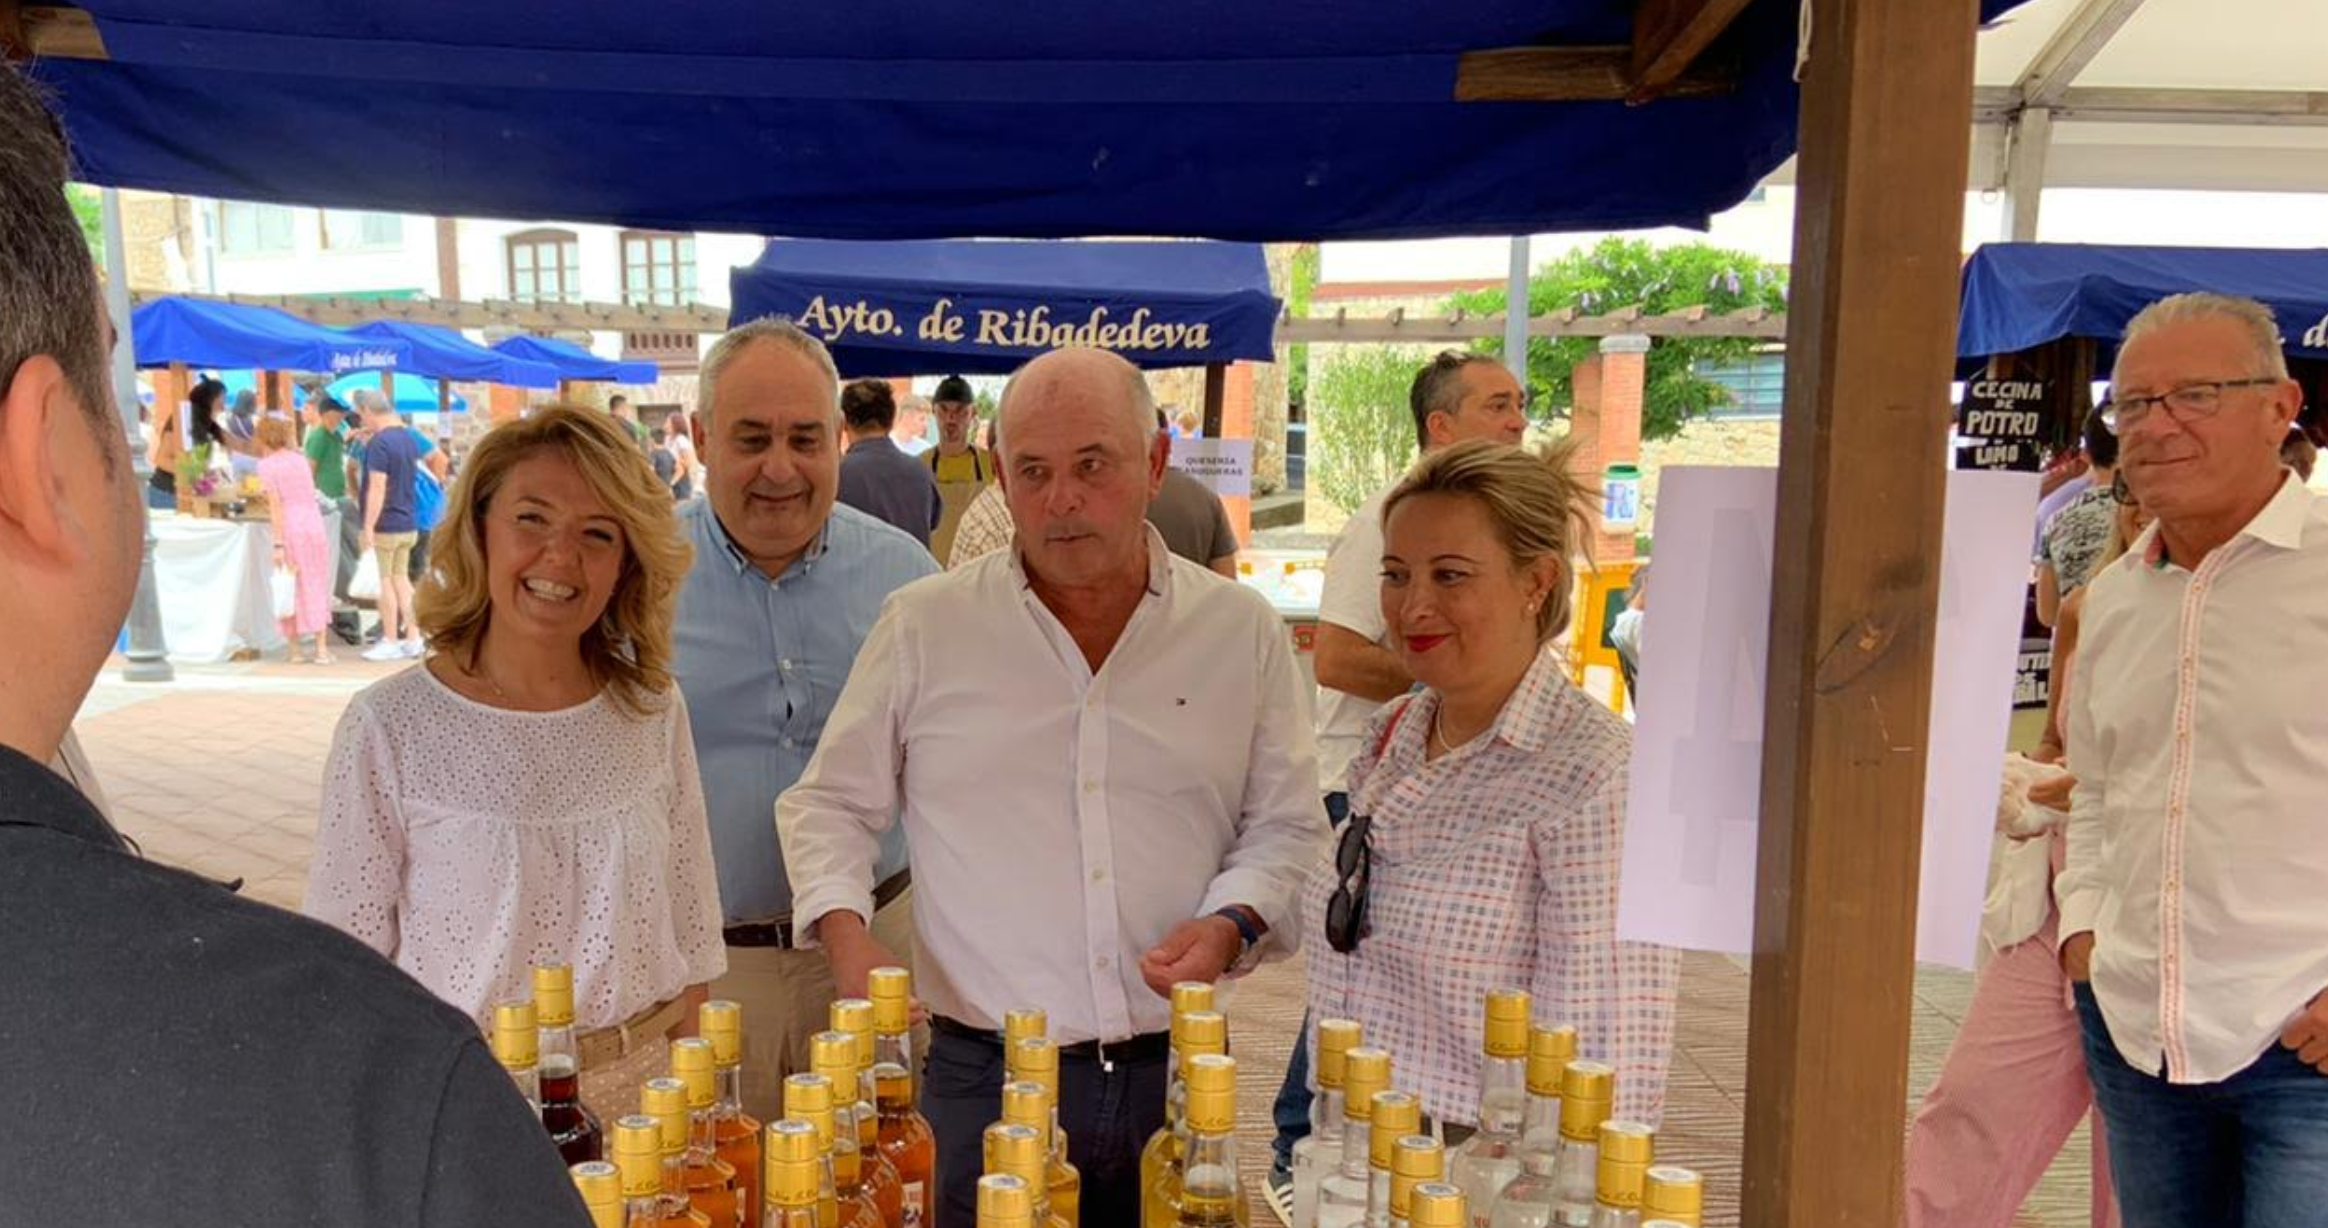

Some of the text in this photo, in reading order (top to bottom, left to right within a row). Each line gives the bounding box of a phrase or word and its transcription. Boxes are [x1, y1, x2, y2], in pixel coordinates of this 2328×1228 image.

[796, 295, 1211, 349] Ayto. de Ribadedeva
[1972, 381, 2042, 400] CECINA
[1965, 410, 2039, 436] POTRO
